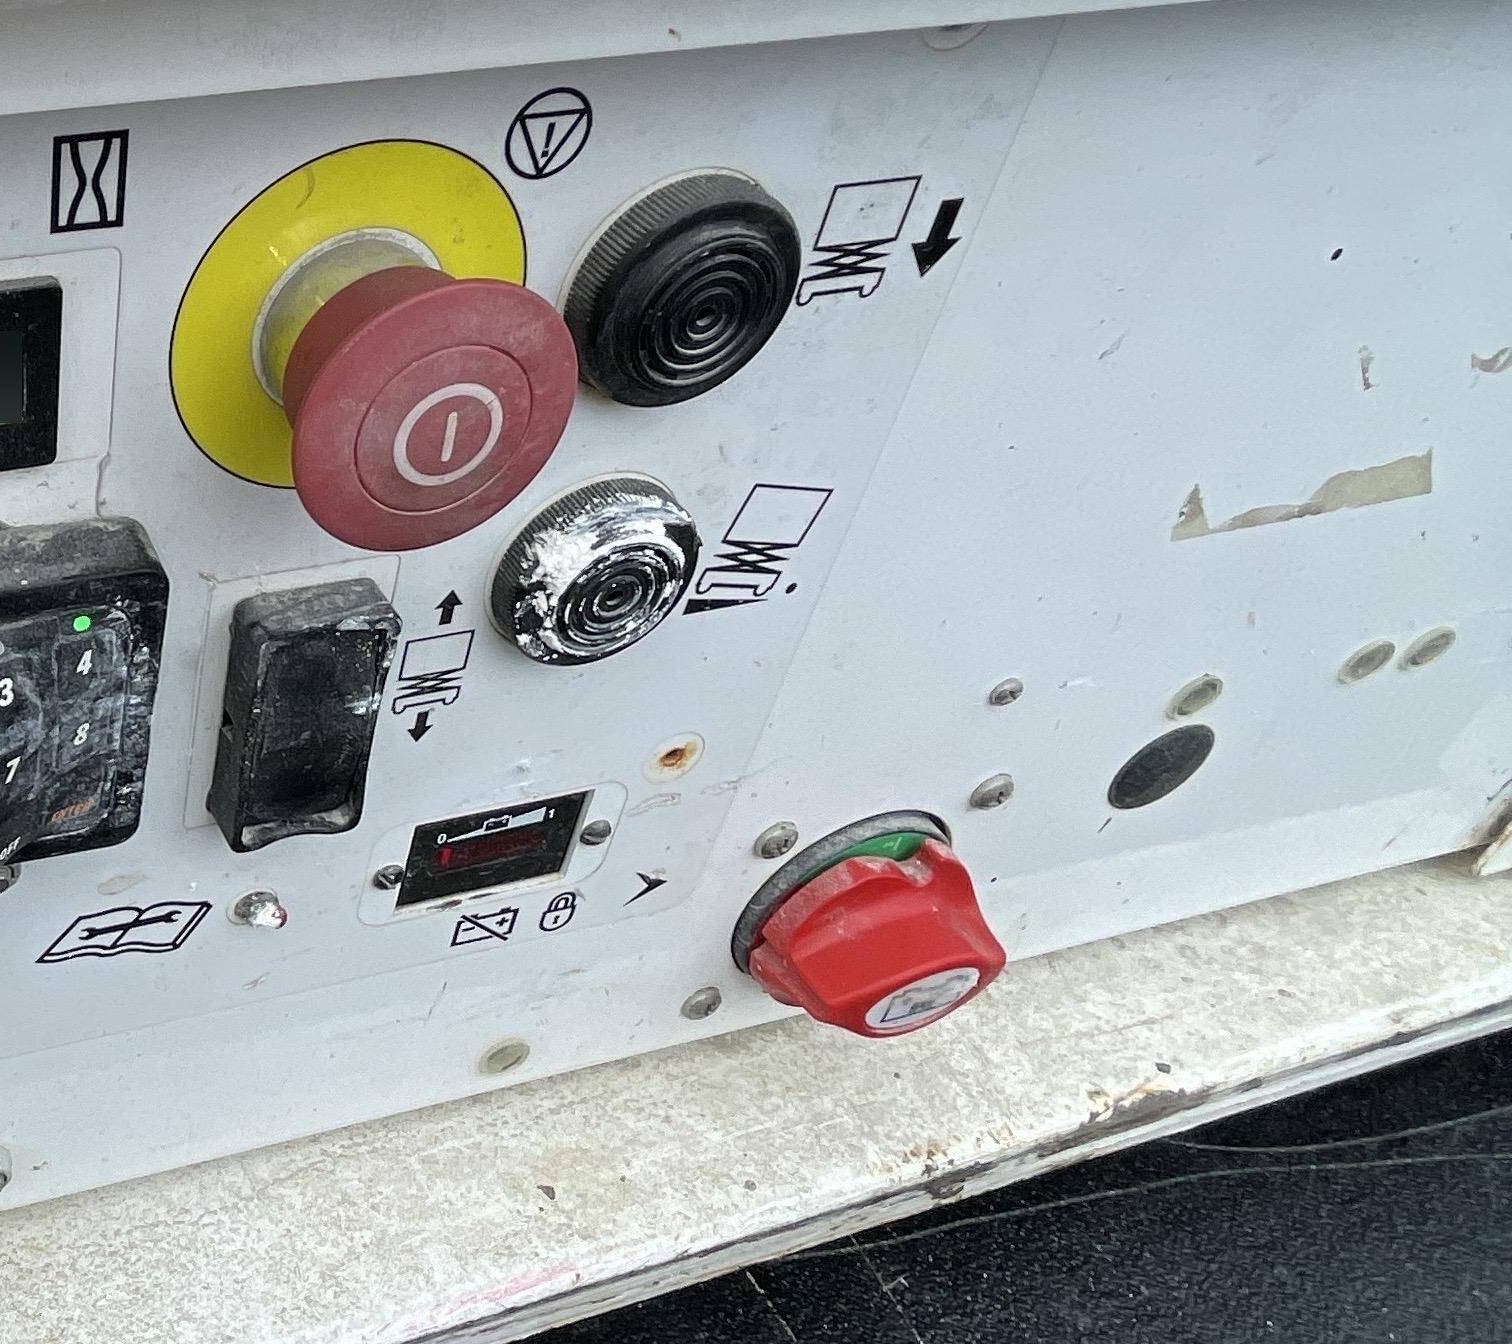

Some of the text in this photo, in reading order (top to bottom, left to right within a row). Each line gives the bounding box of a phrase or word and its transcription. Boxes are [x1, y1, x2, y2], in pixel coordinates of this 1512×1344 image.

[75, 649, 93, 676] 4
[72, 721, 91, 747] 8
[4, 755, 21, 785] 7
[436, 833, 447, 845] 0
